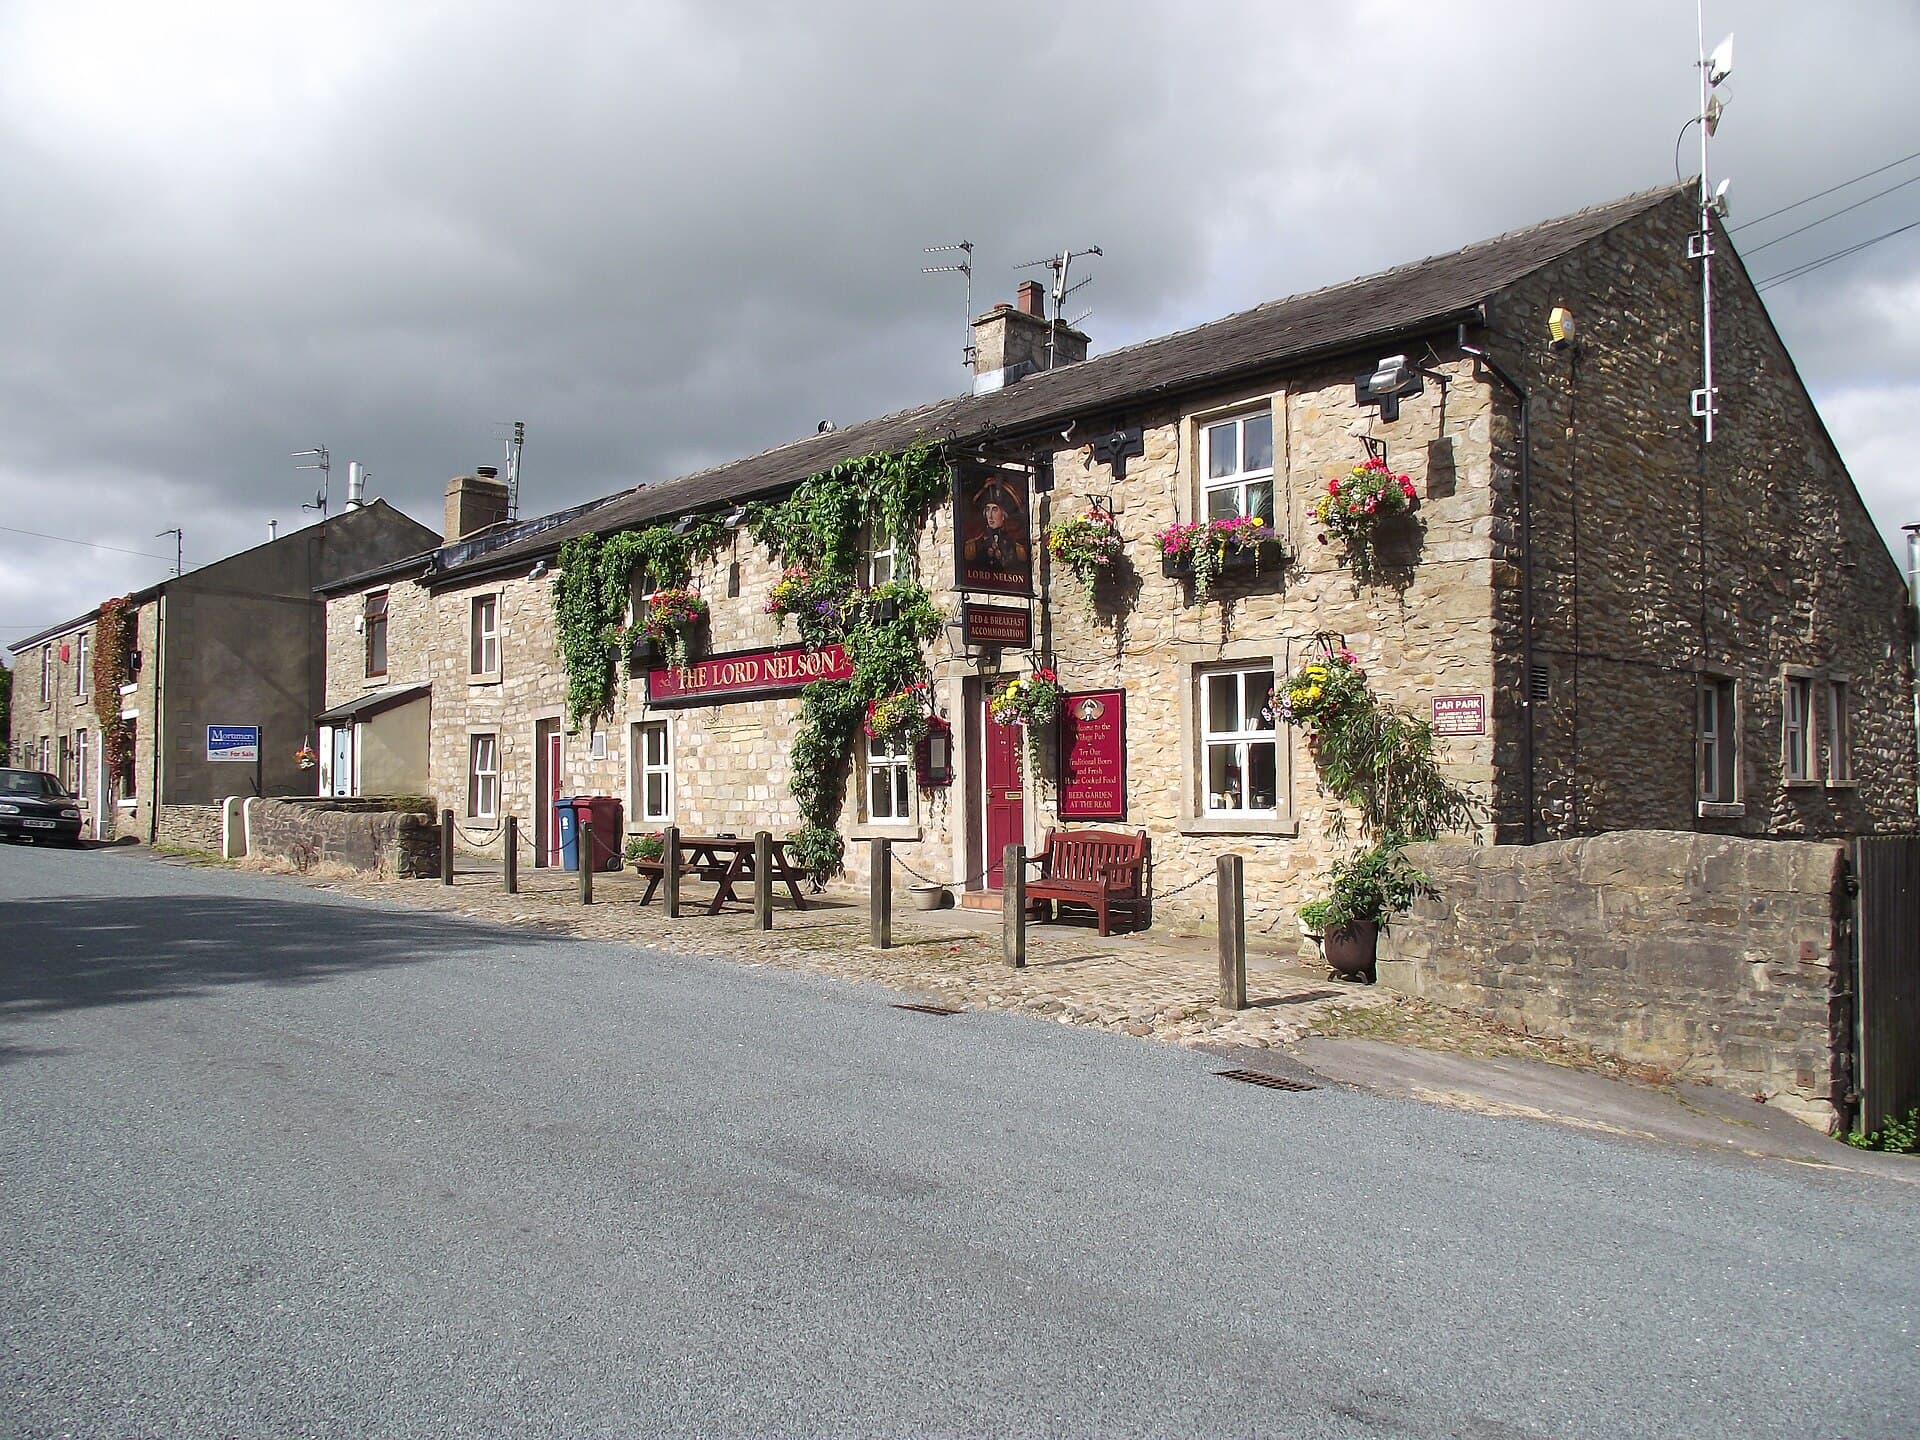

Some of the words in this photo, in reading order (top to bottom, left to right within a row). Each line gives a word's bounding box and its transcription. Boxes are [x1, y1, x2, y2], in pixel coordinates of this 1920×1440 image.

[968, 570, 991, 580] LORD
[993, 572, 1024, 583] NELSON
[970, 614, 982, 624] BED
[990, 616, 1024, 626] BREAKFAST
[971, 626, 1024, 638] ACCOMMODATION
[677, 666, 707, 690] THE
[712, 660, 759, 686] LORD
[763, 651, 836, 681] NELSON
[1435, 700, 1454, 710] CAR
[1456, 700, 1480, 708] PARK
